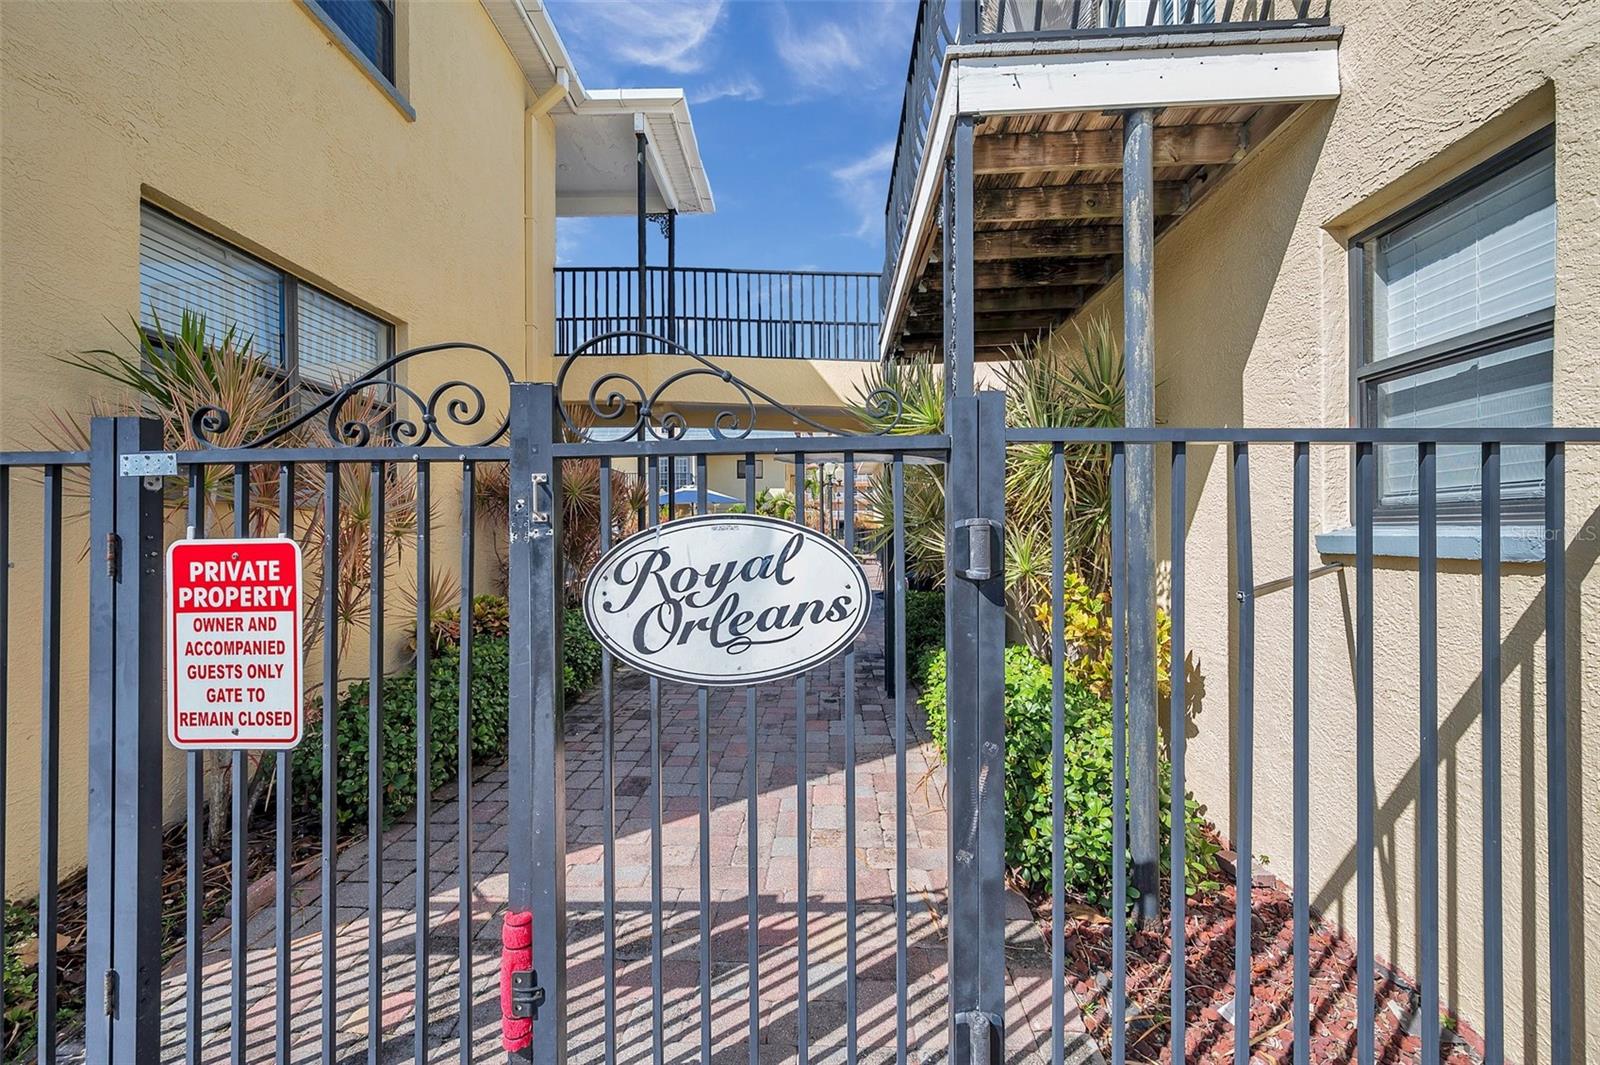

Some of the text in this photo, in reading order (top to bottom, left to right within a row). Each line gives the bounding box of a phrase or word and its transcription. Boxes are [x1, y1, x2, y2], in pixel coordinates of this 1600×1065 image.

[189, 560, 281, 582] PRIVATE
[602, 532, 805, 614] Royal
[178, 585, 293, 608] PROPERTY
[193, 616, 277, 633] OWNER AND
[632, 591, 857, 655] Orleans
[184, 640, 286, 656] ACCOMPANIED
[187, 663, 284, 680] GUESTS ONLY
[206, 687, 265, 703] GATE TO
[179, 711, 292, 727] REMAIN CLOSED
